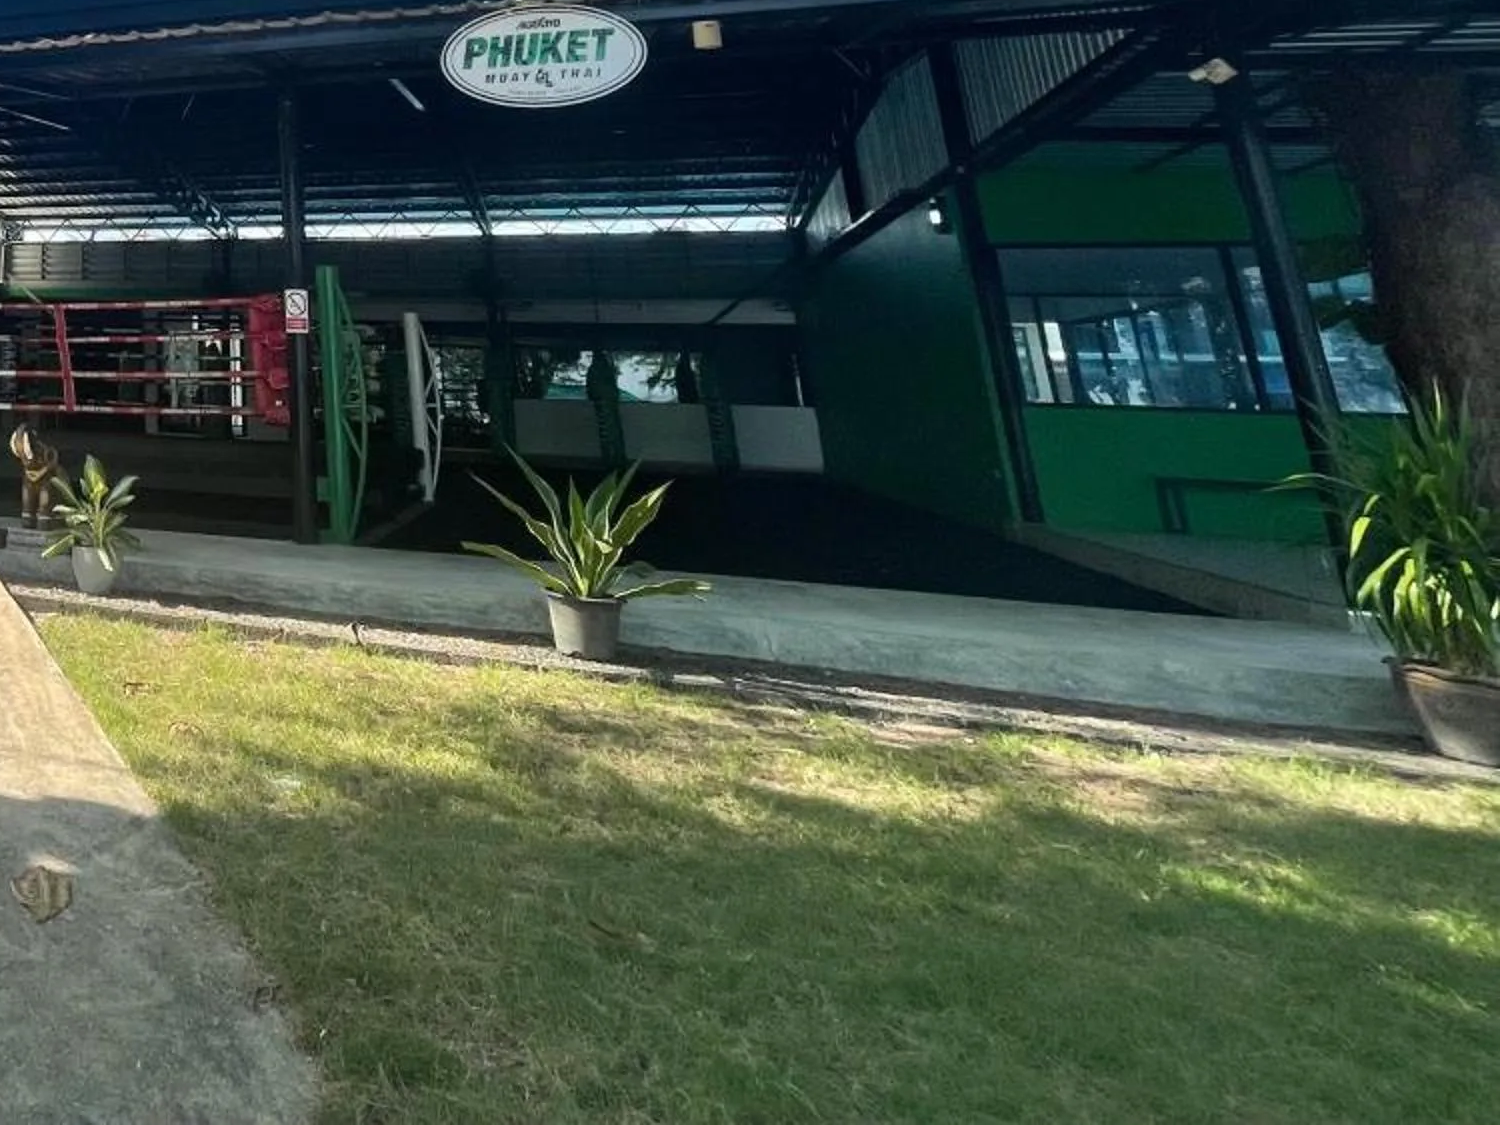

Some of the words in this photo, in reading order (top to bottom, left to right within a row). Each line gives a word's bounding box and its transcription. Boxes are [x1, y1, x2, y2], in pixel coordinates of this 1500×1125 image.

[463, 28, 615, 70] PHUKET
[485, 73, 532, 84] MUAY
[561, 67, 602, 79] THAI
